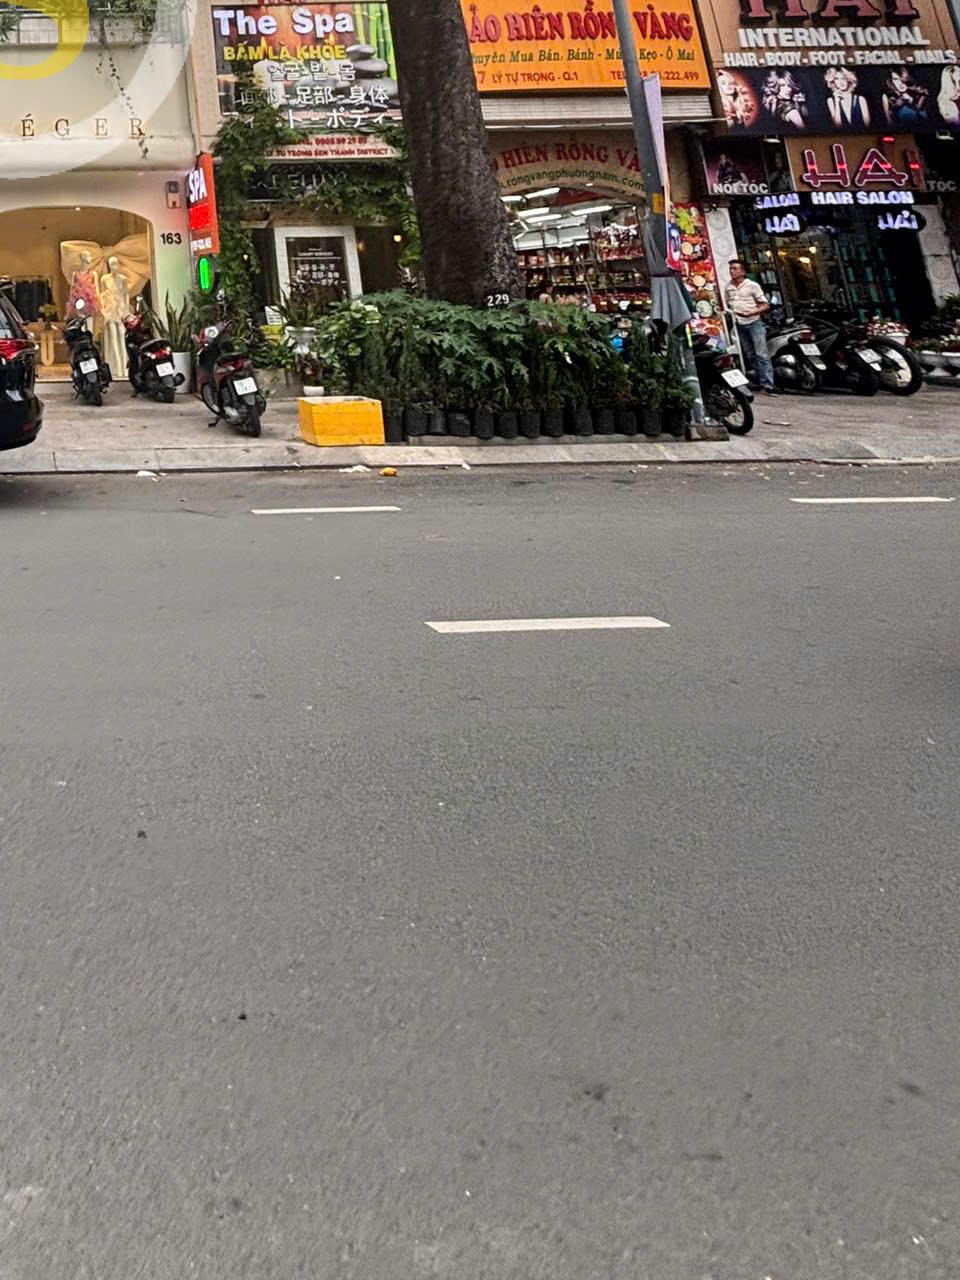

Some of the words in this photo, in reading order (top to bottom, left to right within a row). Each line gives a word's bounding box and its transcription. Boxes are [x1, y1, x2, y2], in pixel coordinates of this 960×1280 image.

[213, 9, 277, 36] The
[292, 7, 355, 38] Spa
[469, 3, 502, 43] ẢO
[504, 4, 566, 42] HIÊN
[633, 3, 694, 42] VÀNG
[738, 26, 930, 48] INTERNATIONAL
[509, 50, 534, 63] Mua
[724, 52, 759, 67] HAIR
[766, 52, 802, 66] BODY
[811, 51, 846, 66] FOOT
[855, 50, 904, 65] FACIAL
[913, 49, 958, 64] NAILS
[521, 71, 555, 85] TRỌNG
[296, 87, 333, 105] 足部
[349, 86, 390, 105] 身体
[189, 168, 208, 203] SPA
[811, 191, 854, 205] HAIR
[856, 191, 914, 205] SALON
[160, 233, 182, 245] 163
[487, 293, 510, 307] 229
